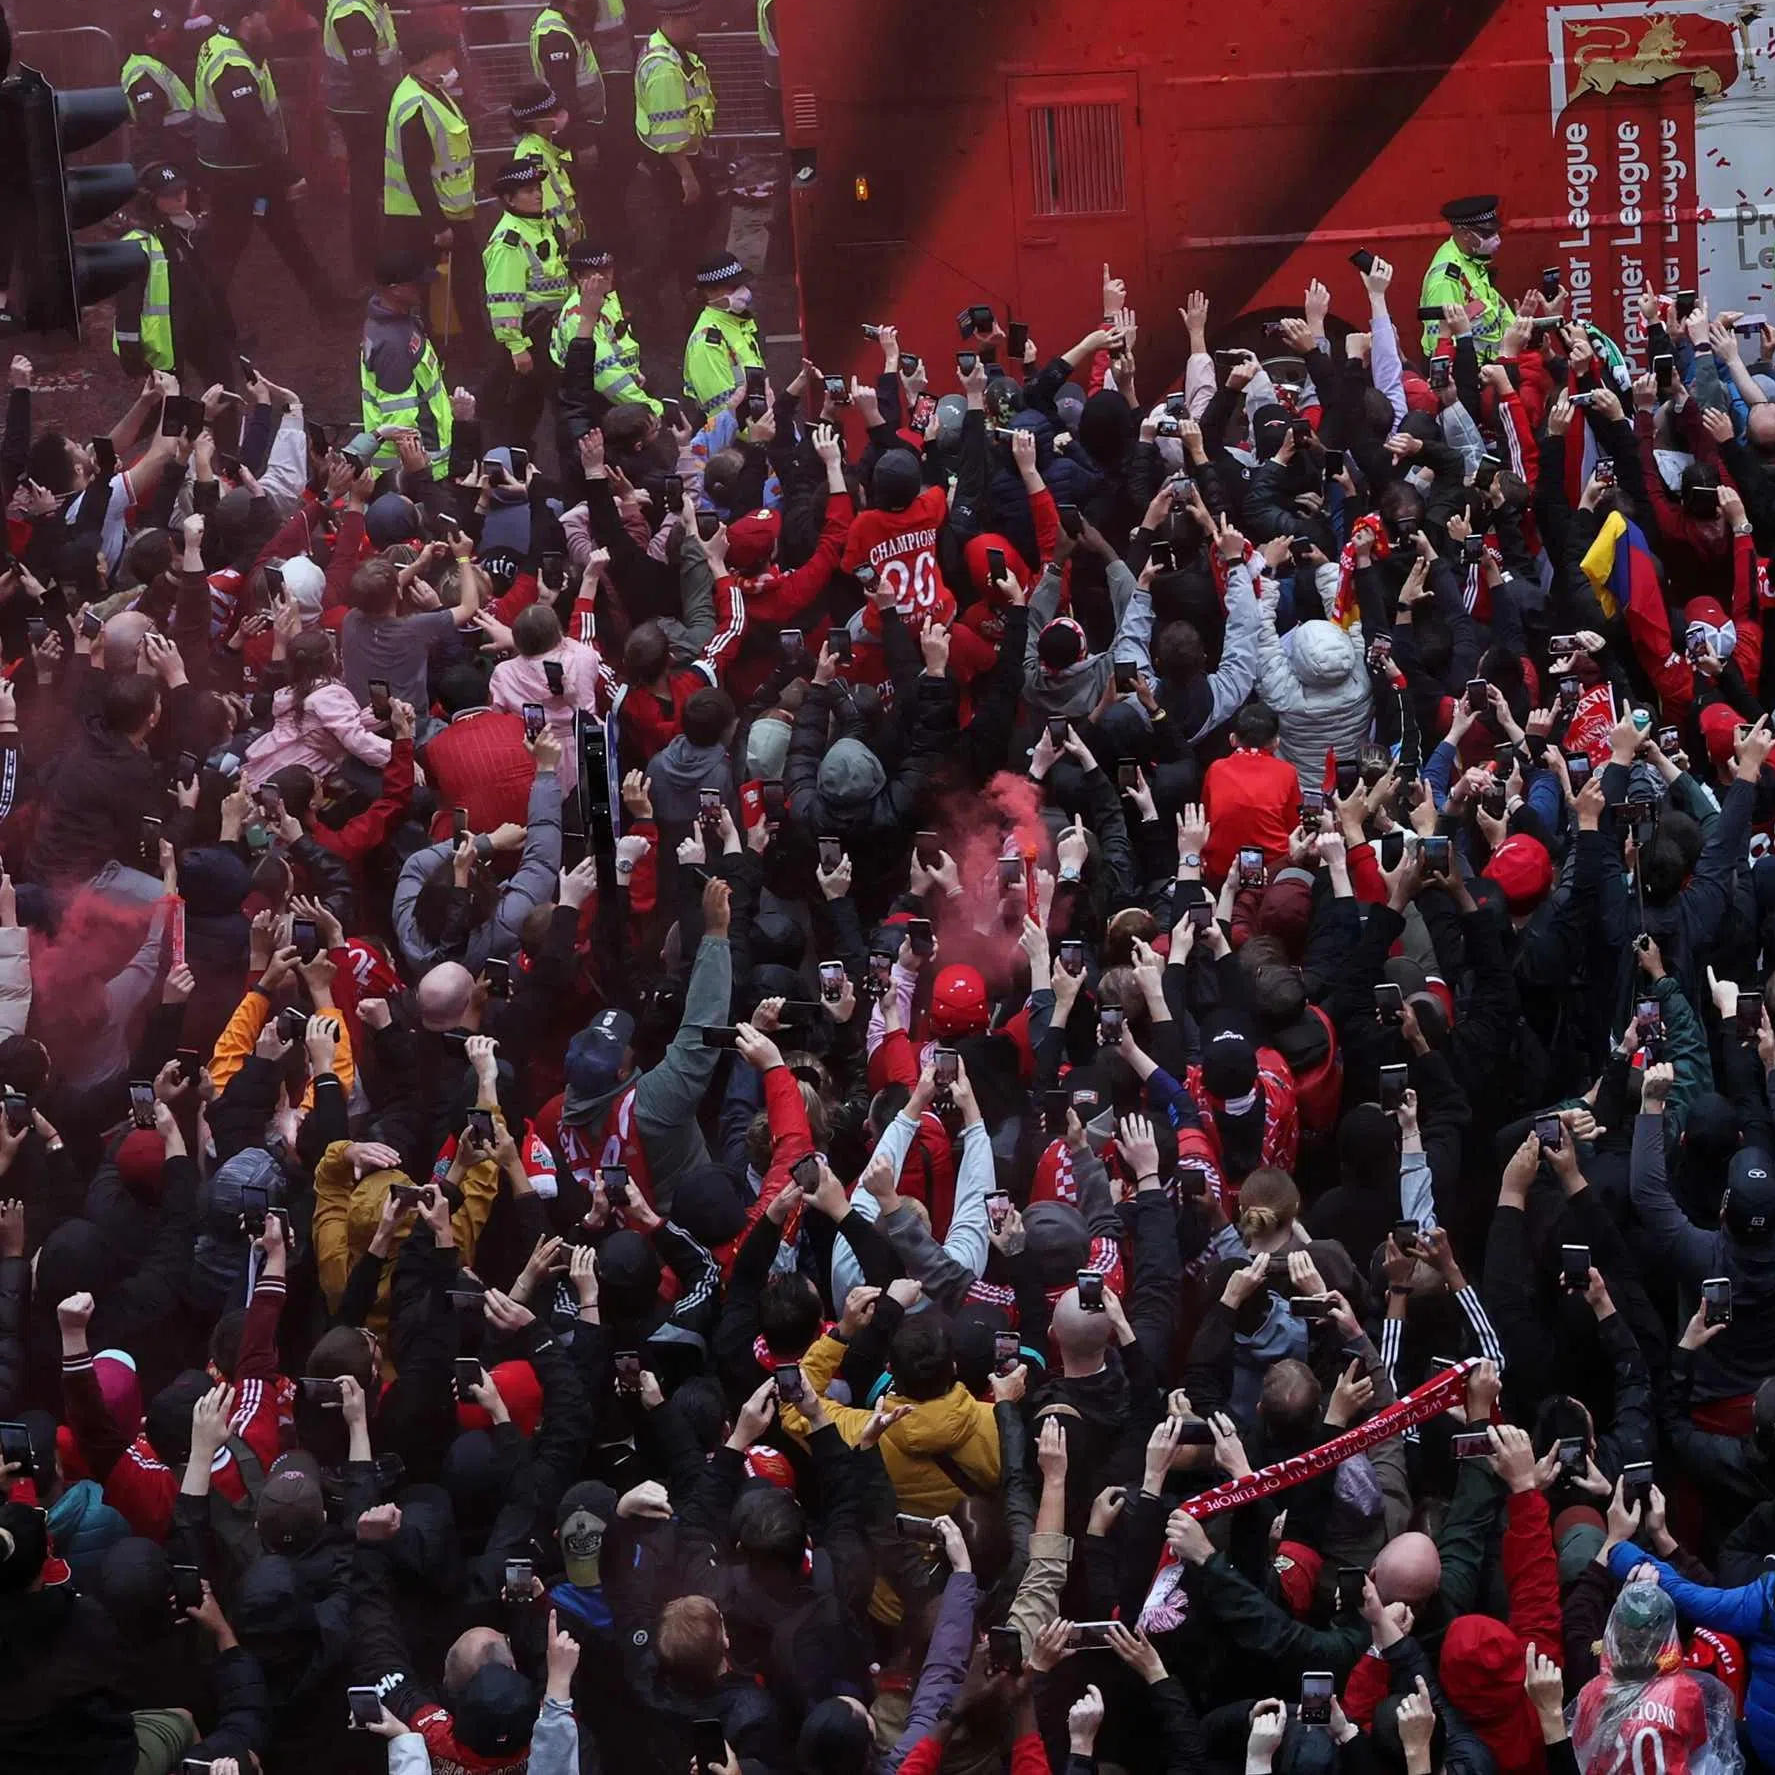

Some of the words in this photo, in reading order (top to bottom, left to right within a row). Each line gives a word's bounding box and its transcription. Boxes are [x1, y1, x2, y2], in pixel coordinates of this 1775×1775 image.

[1559, 122, 1598, 248] League
[1610, 121, 1650, 246] League
[880, 551, 935, 615] 20
[1259, 1477, 1282, 1494] OF
[1285, 1465, 1310, 1483] ALL
[1206, 1486, 1258, 1513] EUROPE
